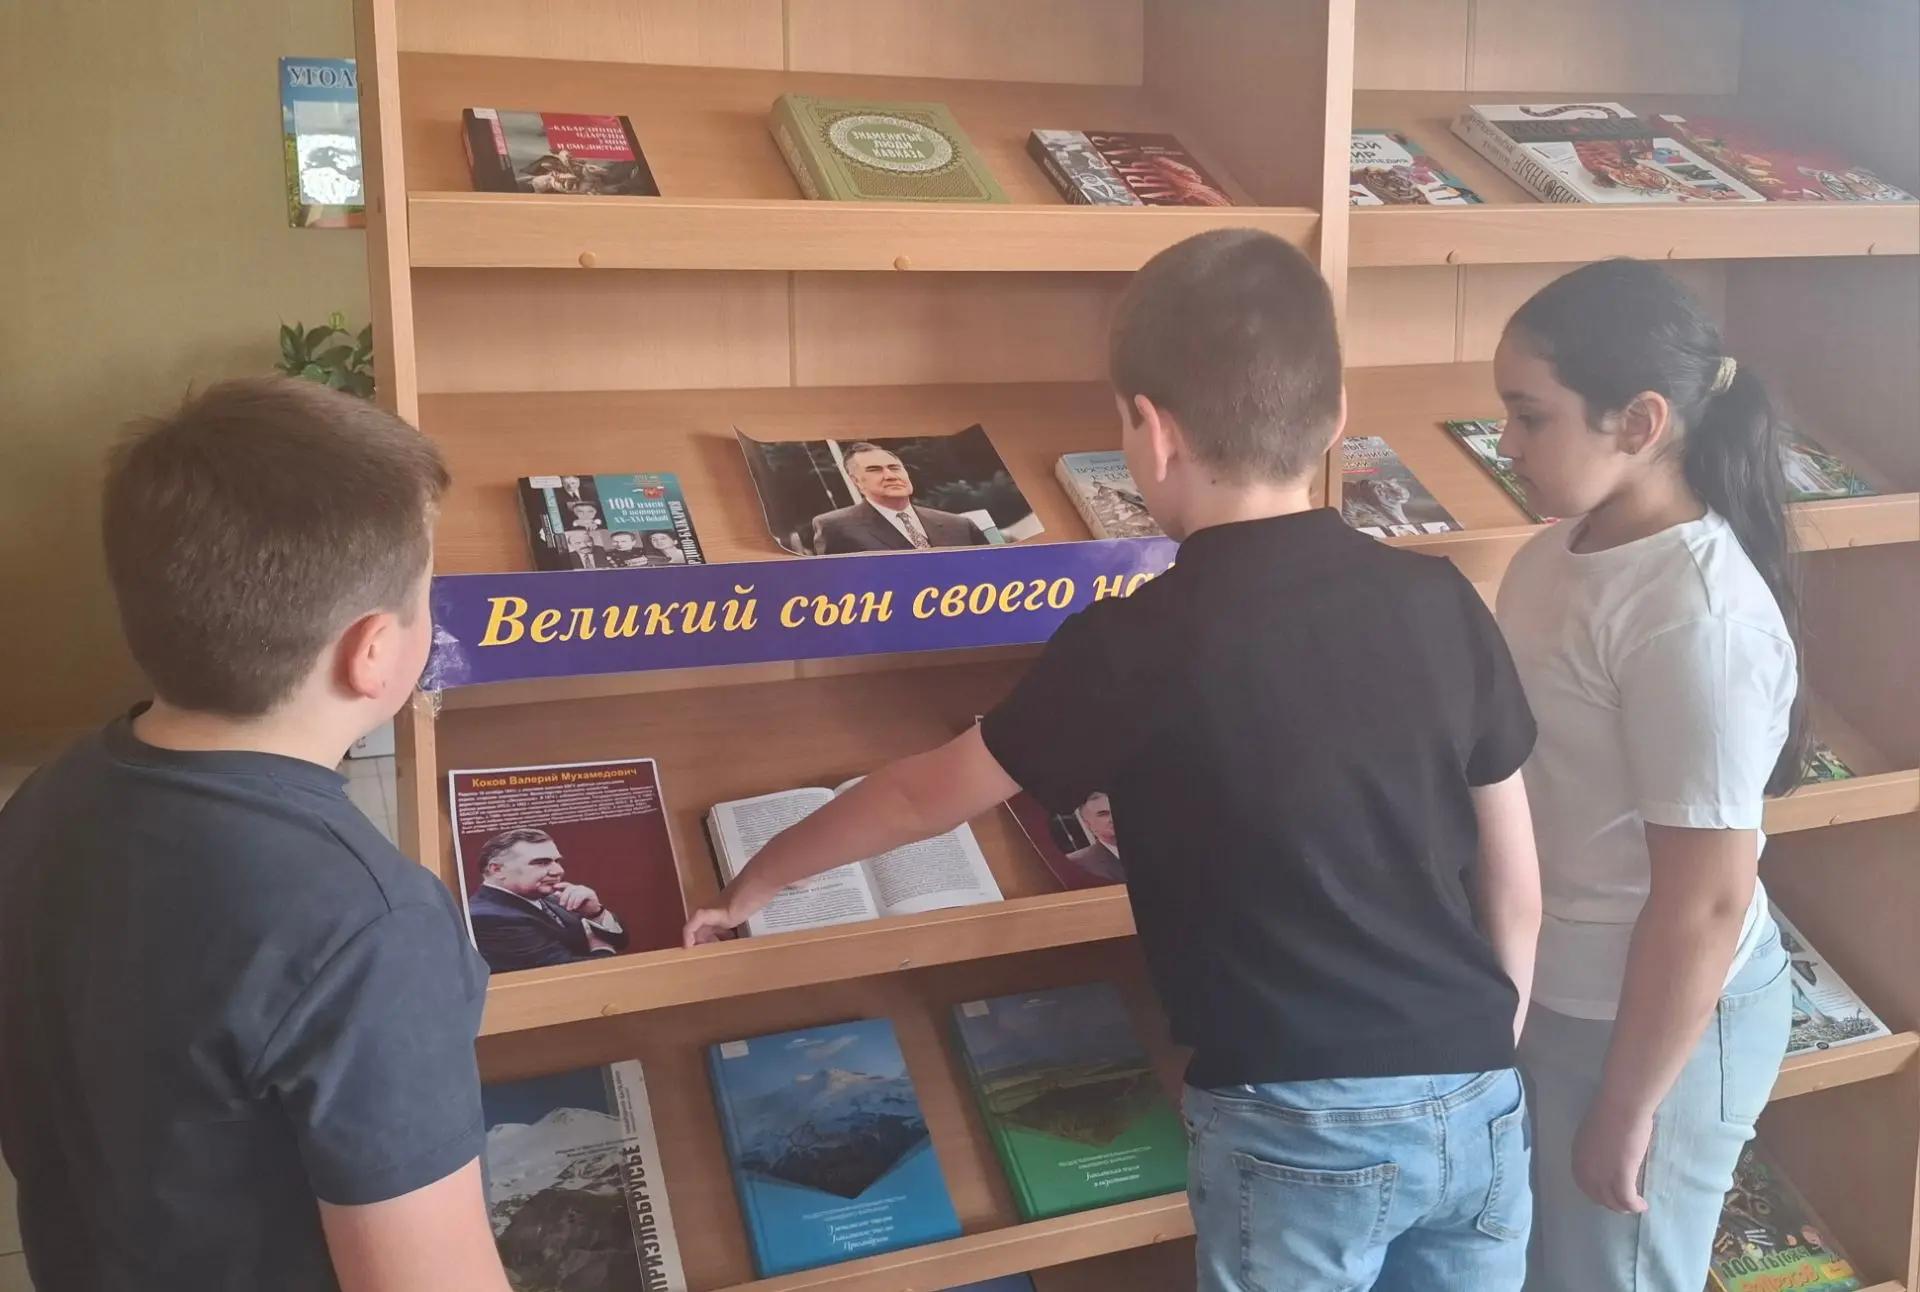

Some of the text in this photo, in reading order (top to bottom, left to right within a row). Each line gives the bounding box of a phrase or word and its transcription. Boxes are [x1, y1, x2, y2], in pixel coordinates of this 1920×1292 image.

[873, 140, 913, 150] ЛЮДИ
[1351, 141, 1382, 150] ОЙ
[608, 497, 635, 509] 100
[478, 562, 1176, 647] Великий сын своего на
[472, 769, 637, 788] Коков Валерий Мухамедович
